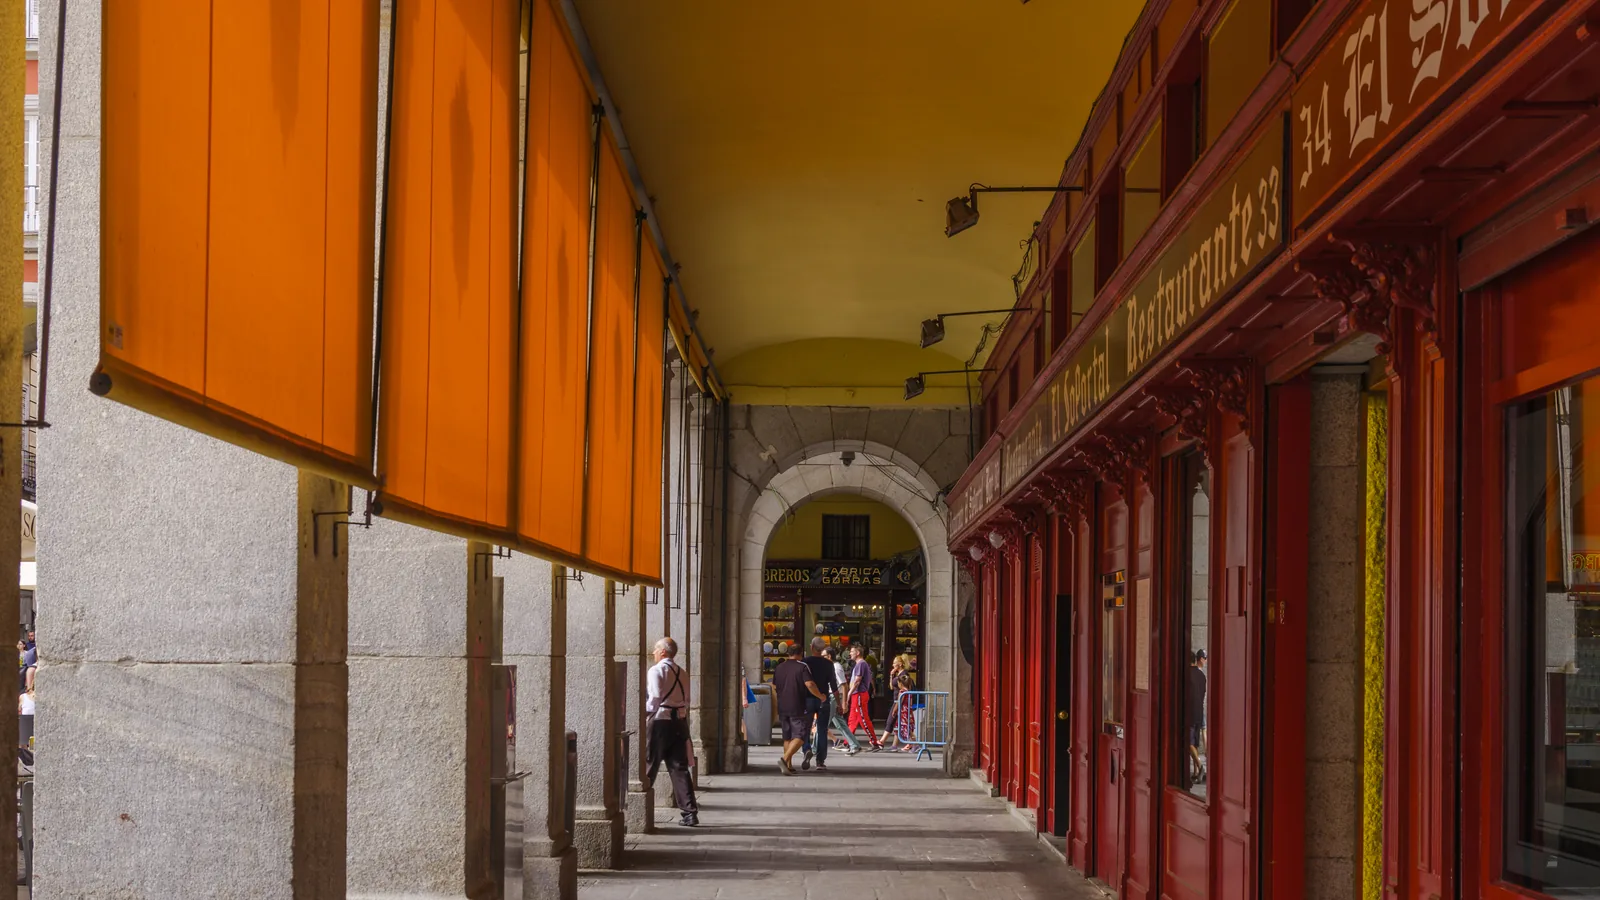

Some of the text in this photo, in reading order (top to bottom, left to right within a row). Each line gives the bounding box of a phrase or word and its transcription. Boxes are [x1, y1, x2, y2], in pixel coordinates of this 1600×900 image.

[1300, 0, 1511, 191] 34 El So
[1127, 183, 1253, 376] Restaurante
[1257, 165, 1280, 250] 33
[822, 567, 881, 576] FABRICA
[822, 576, 881, 585] GORRAS
